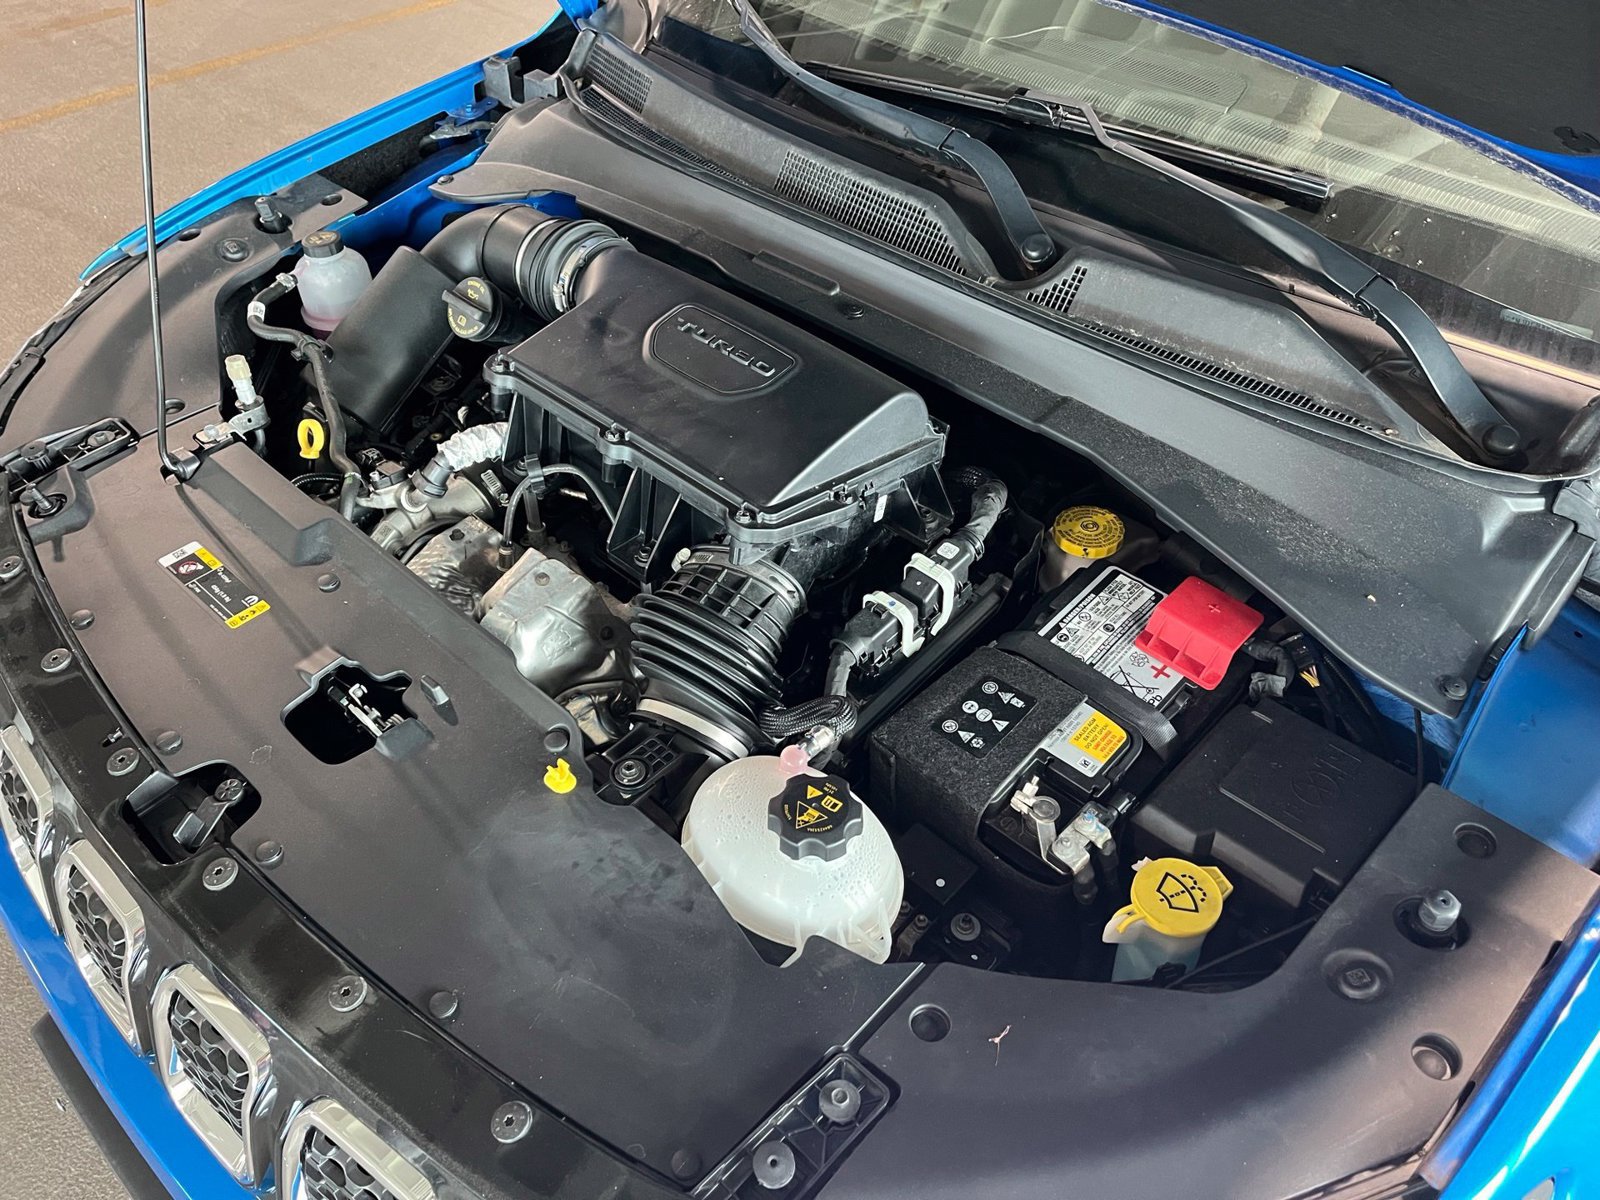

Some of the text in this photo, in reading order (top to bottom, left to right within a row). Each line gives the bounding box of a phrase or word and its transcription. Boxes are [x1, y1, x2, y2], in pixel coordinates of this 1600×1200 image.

[677, 317, 776, 377] TURBO
[1148, 694, 1164, 707] Pb
[1074, 725, 1089, 741] SEALED
[1083, 723, 1100, 741] BATTERY
